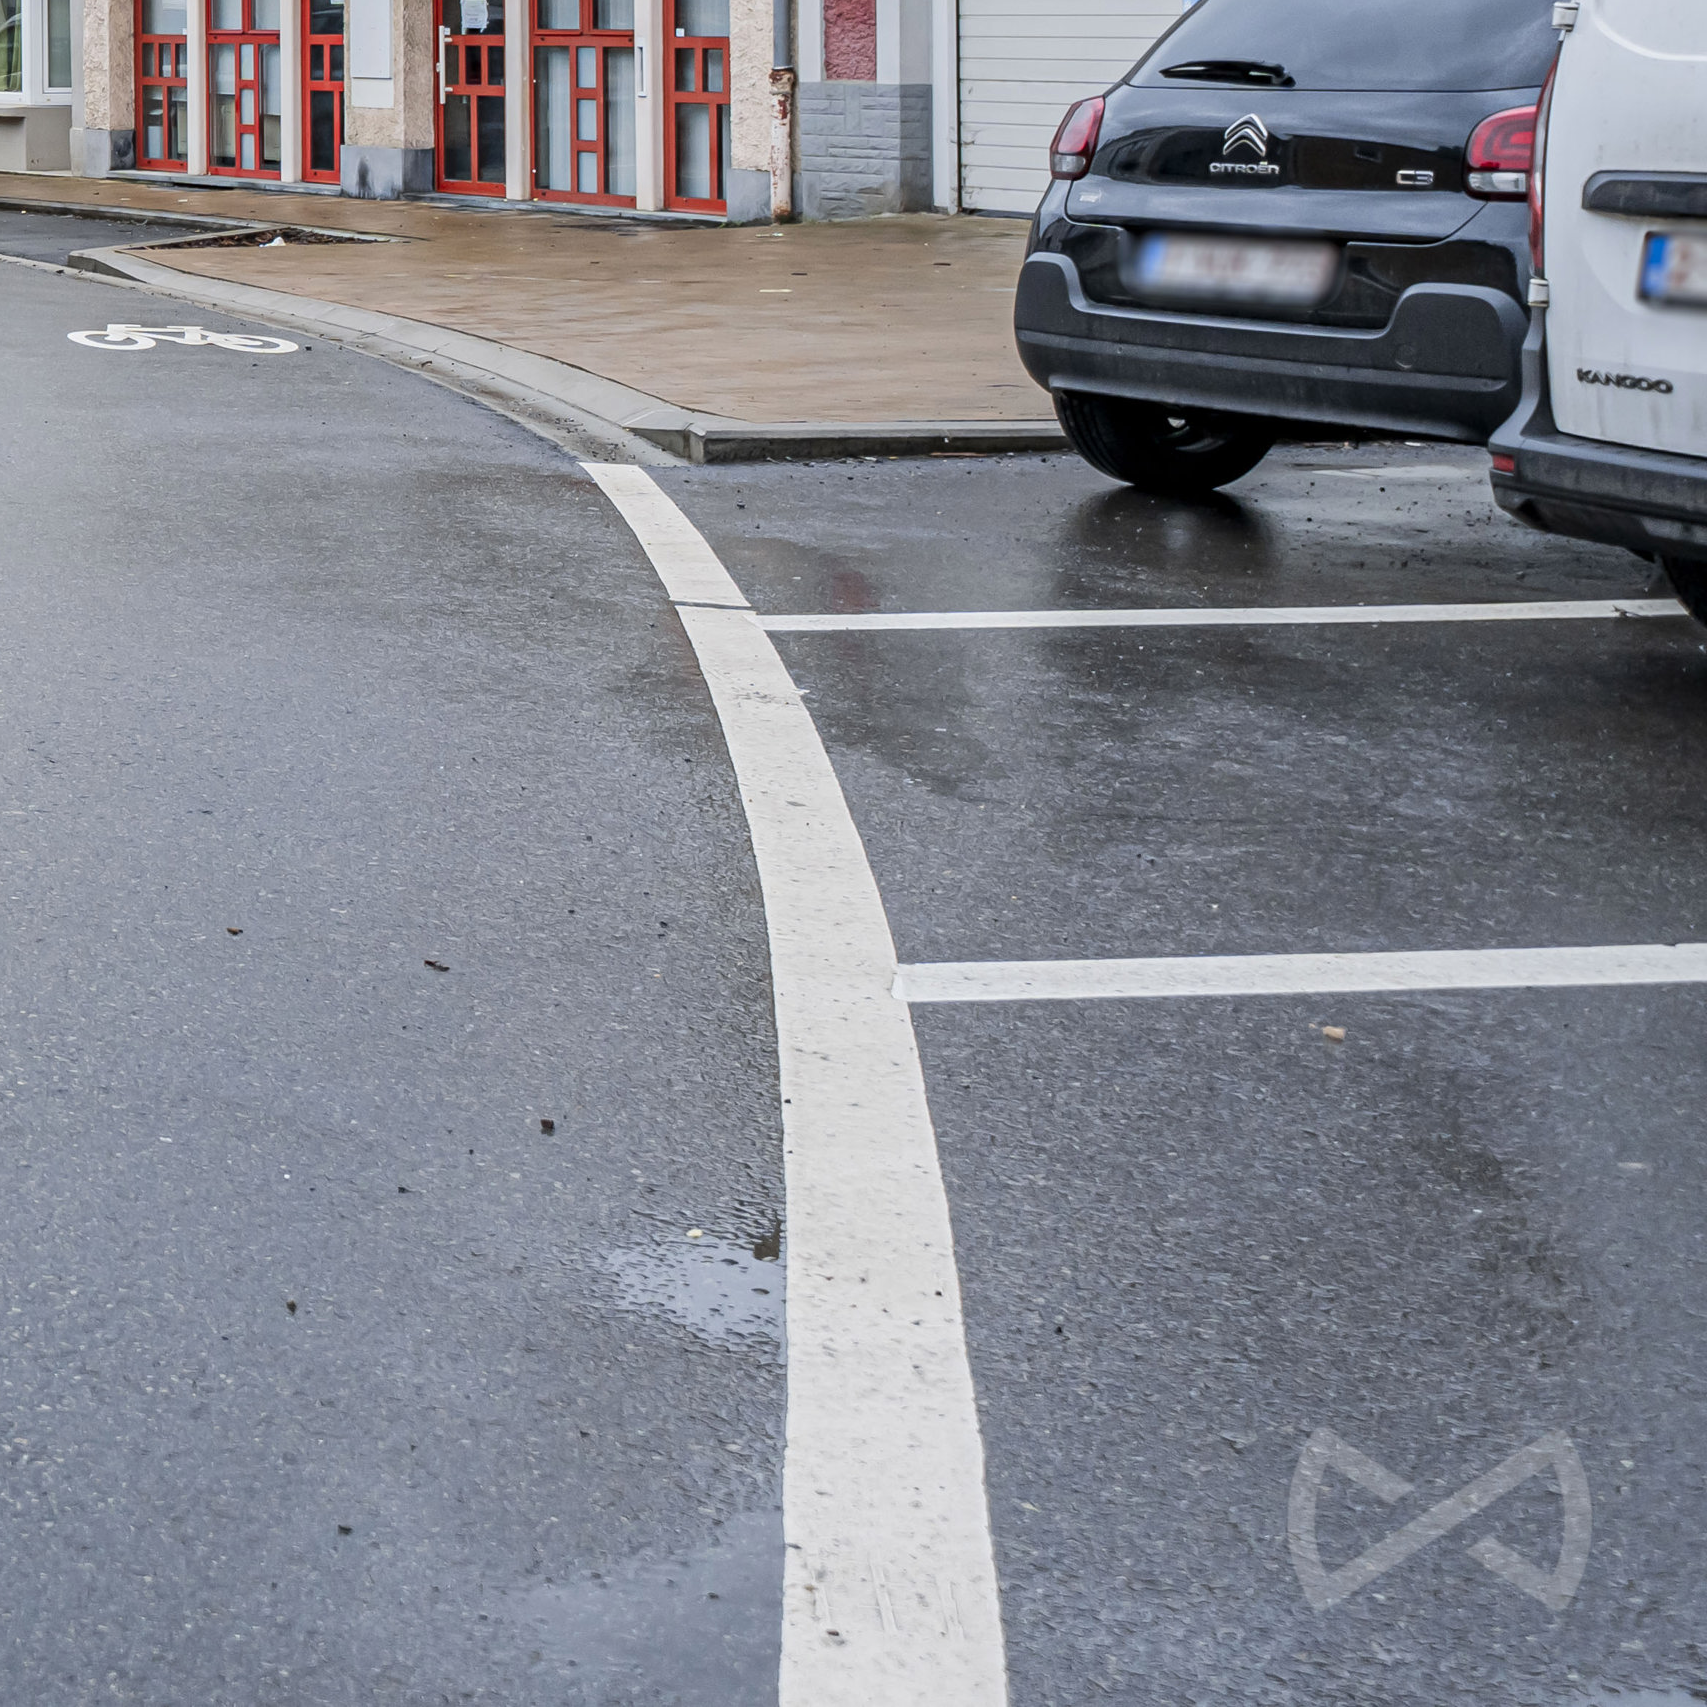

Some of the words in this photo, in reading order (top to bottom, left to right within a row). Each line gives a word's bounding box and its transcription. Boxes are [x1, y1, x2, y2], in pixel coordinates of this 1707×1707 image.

[1209, 161, 1280, 175] CITROËN
[1396, 170, 1434, 185] C3
[1577, 368, 1674, 394] KANGOO
